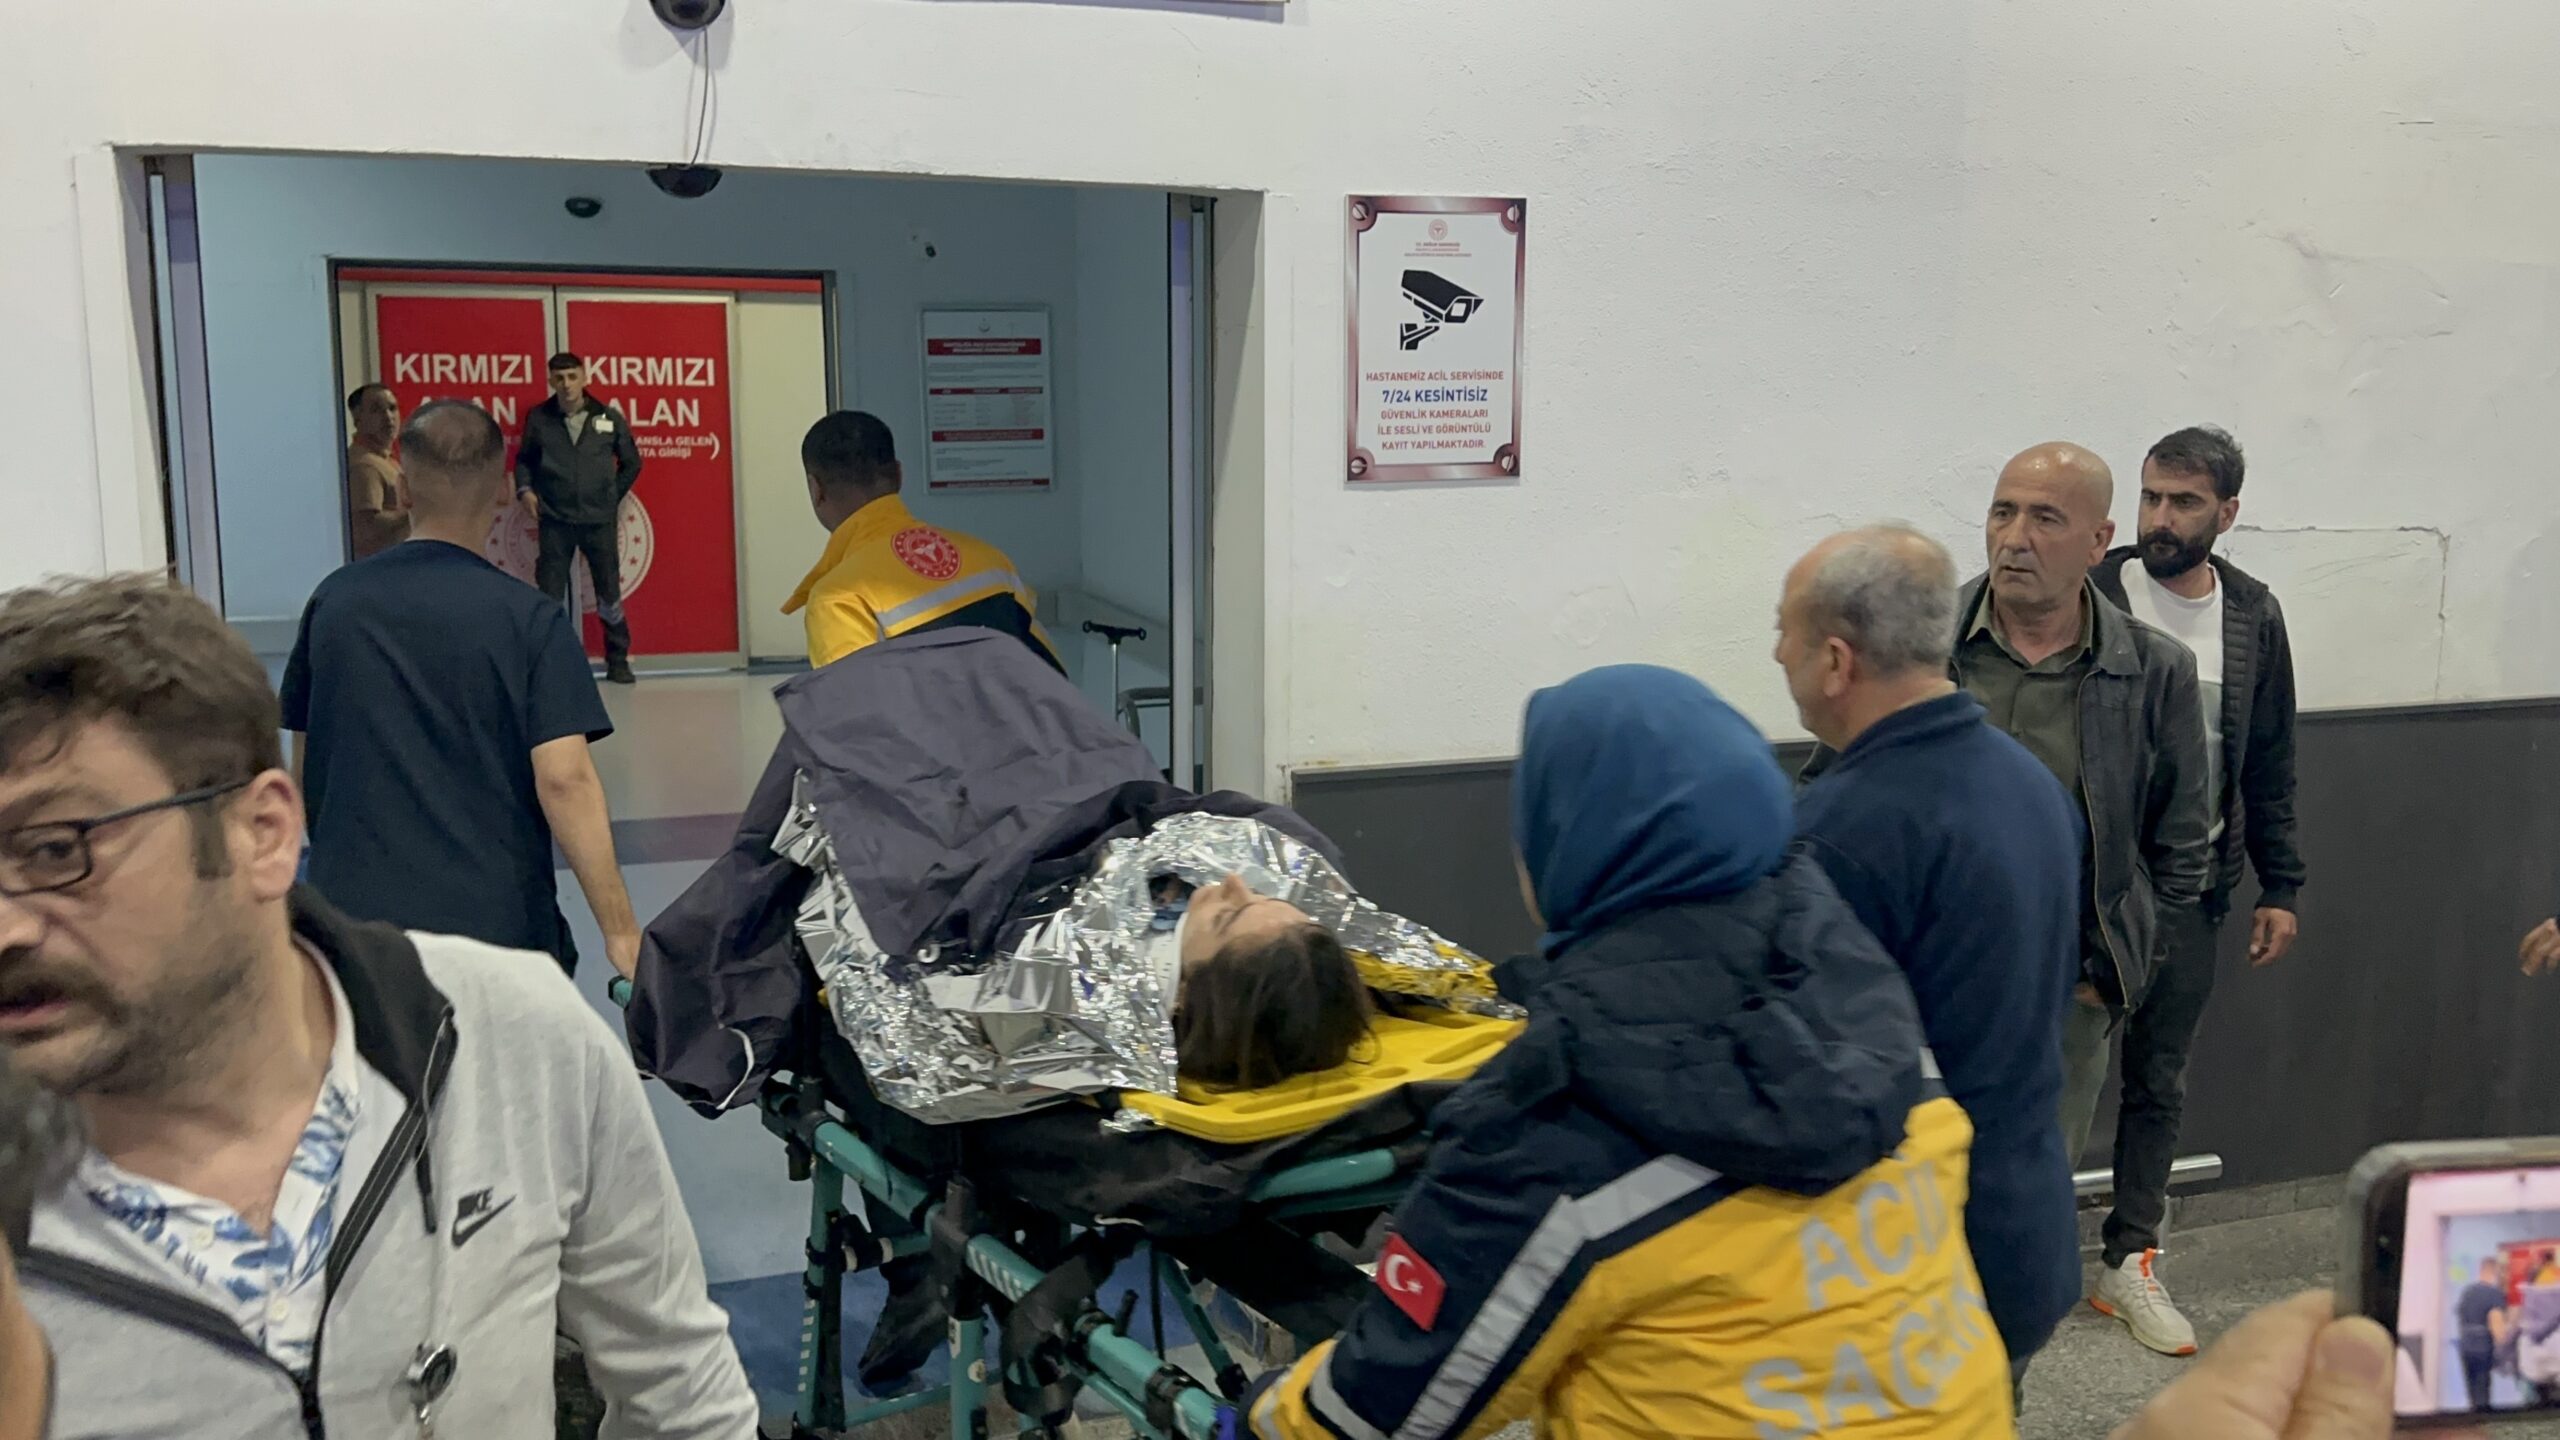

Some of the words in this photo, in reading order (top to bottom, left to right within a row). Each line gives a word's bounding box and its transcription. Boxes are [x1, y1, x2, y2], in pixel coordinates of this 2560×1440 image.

[395, 353, 532, 384] KIRMIZI
[583, 356, 715, 387] KIRMIZI
[1366, 371, 1425, 381] HASTANEMİZ
[1427, 370, 1448, 381] ACİL
[1450, 369, 1504, 380] SERVİSİNDE
[1382, 389, 1411, 404] 7/24
[1415, 386, 1488, 402] KESİNTİSİZ
[1381, 409, 1427, 419] GÜVENLİK
[1429, 409, 1488, 418] KAMERALARI
[1377, 424, 1392, 435] İLE
[1394, 423, 1420, 434] SESLİ
[1422, 425, 1433, 434] VE
[1436, 421, 1491, 434] GÖRÜNTÜLÜ
[1382, 441, 1408, 450] KAYIT
